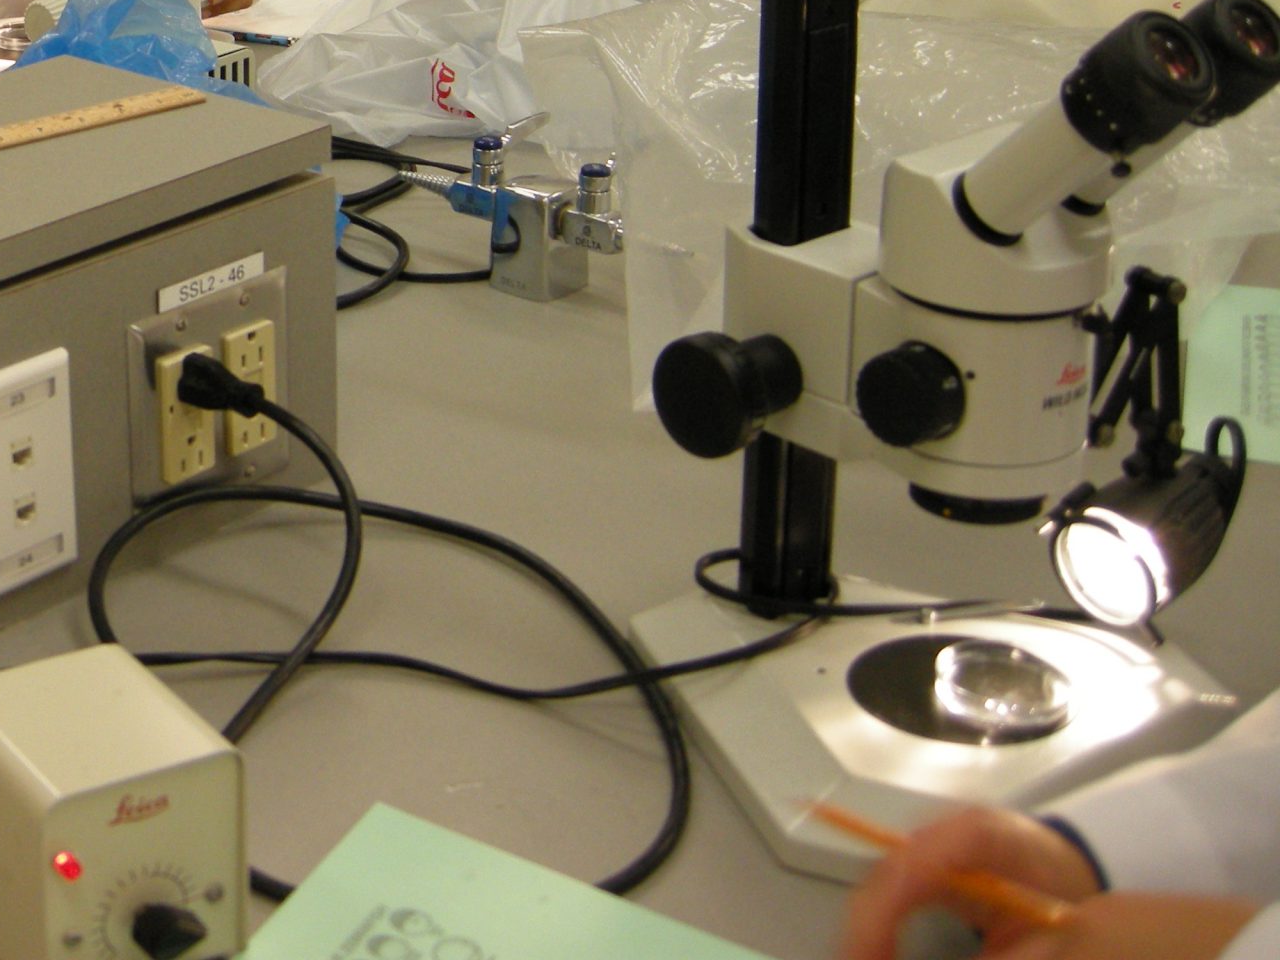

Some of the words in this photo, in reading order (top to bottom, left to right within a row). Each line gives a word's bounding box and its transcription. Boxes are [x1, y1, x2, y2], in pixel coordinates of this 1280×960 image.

[575, 236, 602, 251] DELTA
[179, 276, 216, 302] SSL2
[228, 265, 245, 283] 46
[107, 793, 170, 828] Leica
